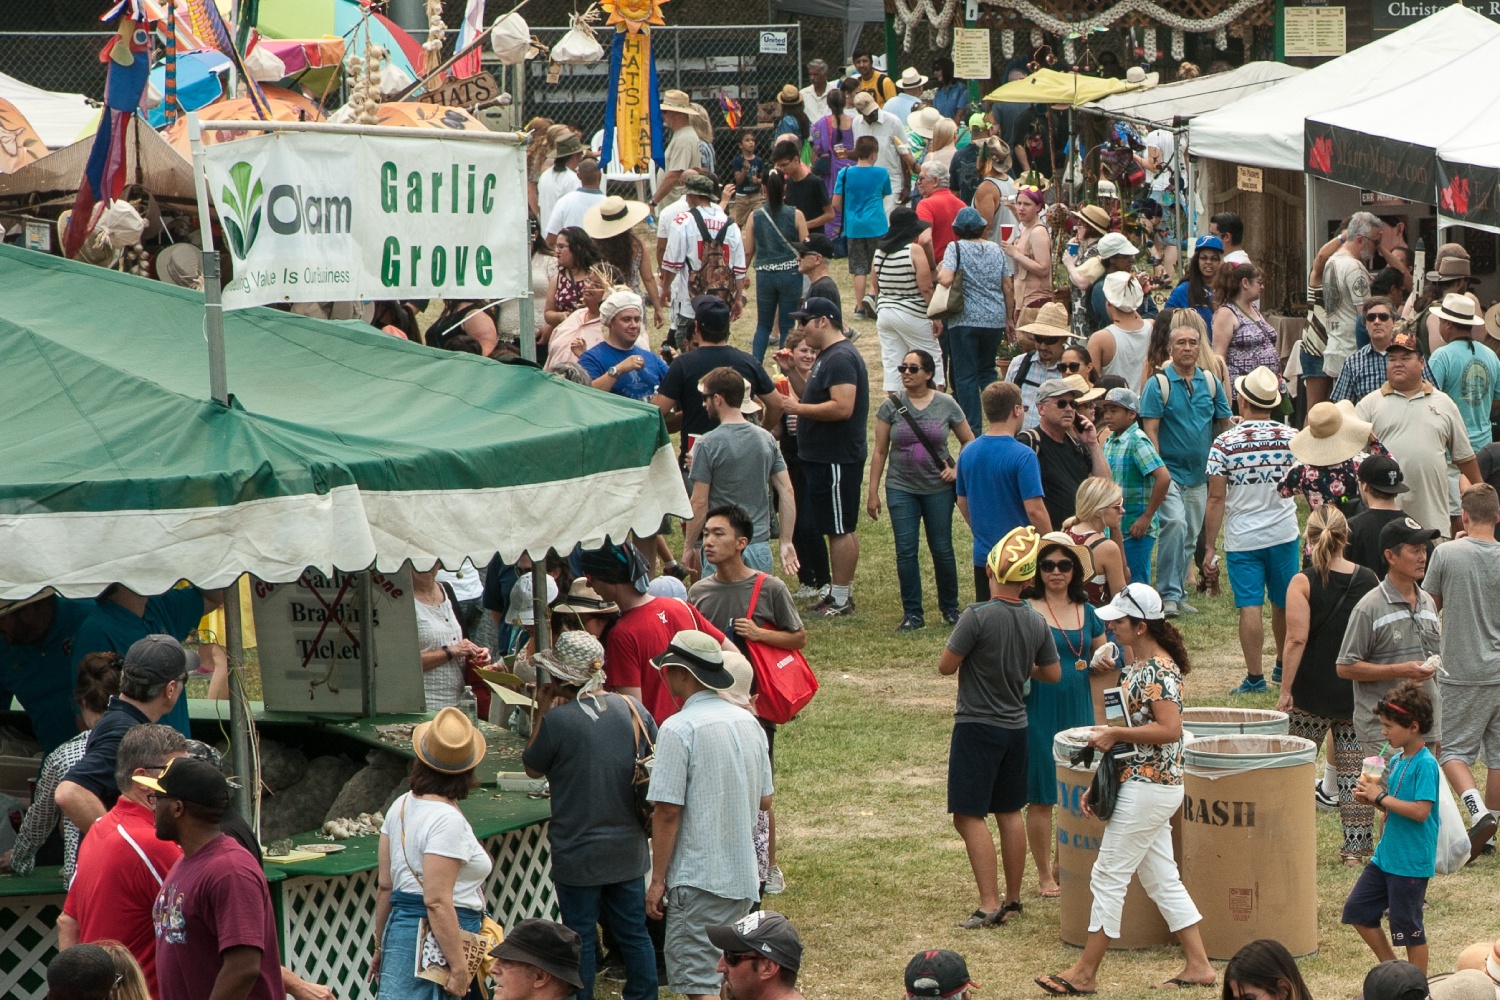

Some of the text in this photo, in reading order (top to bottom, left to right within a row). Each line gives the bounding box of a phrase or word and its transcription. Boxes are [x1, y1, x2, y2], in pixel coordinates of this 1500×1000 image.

[381, 161, 496, 214] Garlic
[267, 184, 351, 235] Olam
[251, 272, 276, 287] Value
[283, 268, 298, 284] Is
[381, 235, 493, 287] Grove
[1183, 794, 1257, 828] RASH
[1392, 930, 1422, 940] 19 47
[470, 940, 487, 976] GILROY
